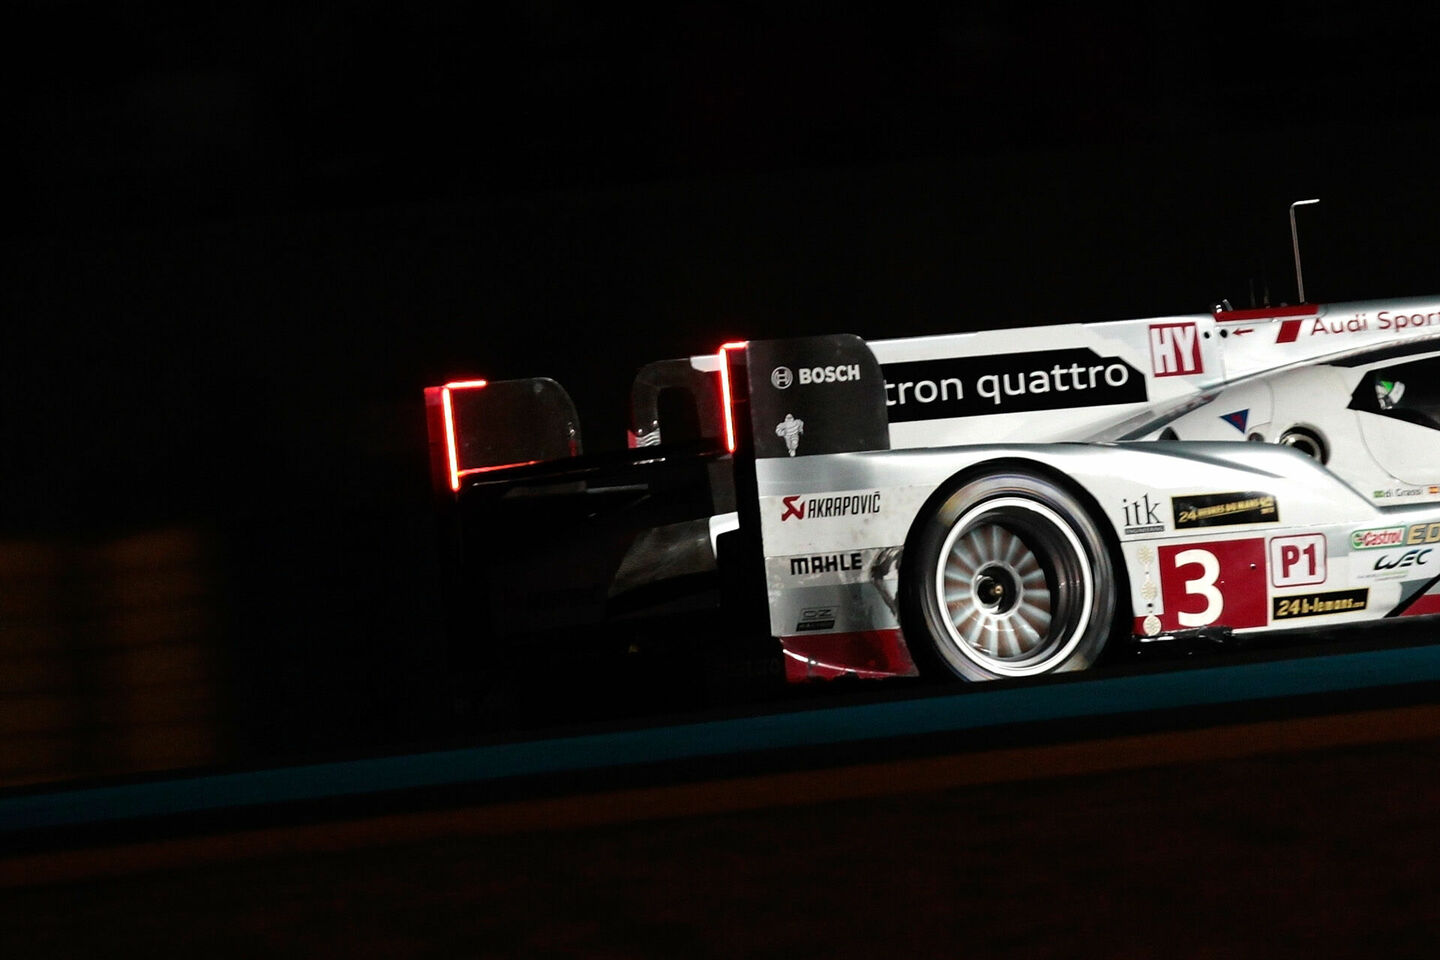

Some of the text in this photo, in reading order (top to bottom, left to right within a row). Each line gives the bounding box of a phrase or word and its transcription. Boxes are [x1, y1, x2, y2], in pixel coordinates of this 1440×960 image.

[1311, 313, 1367, 336] Audi
[1152, 326, 1200, 374] HY
[799, 364, 861, 385] BOSCH
[977, 363, 1129, 404] quattro
[1122, 493, 1164, 527] itk
[1178, 511, 1198, 523] 24
[1363, 529, 1403, 546] Castrol
[790, 552, 863, 575] MAHLE
[1281, 543, 1316, 578] P1
[1373, 548, 1433, 571] WEC
[1174, 549, 1224, 627] 3
